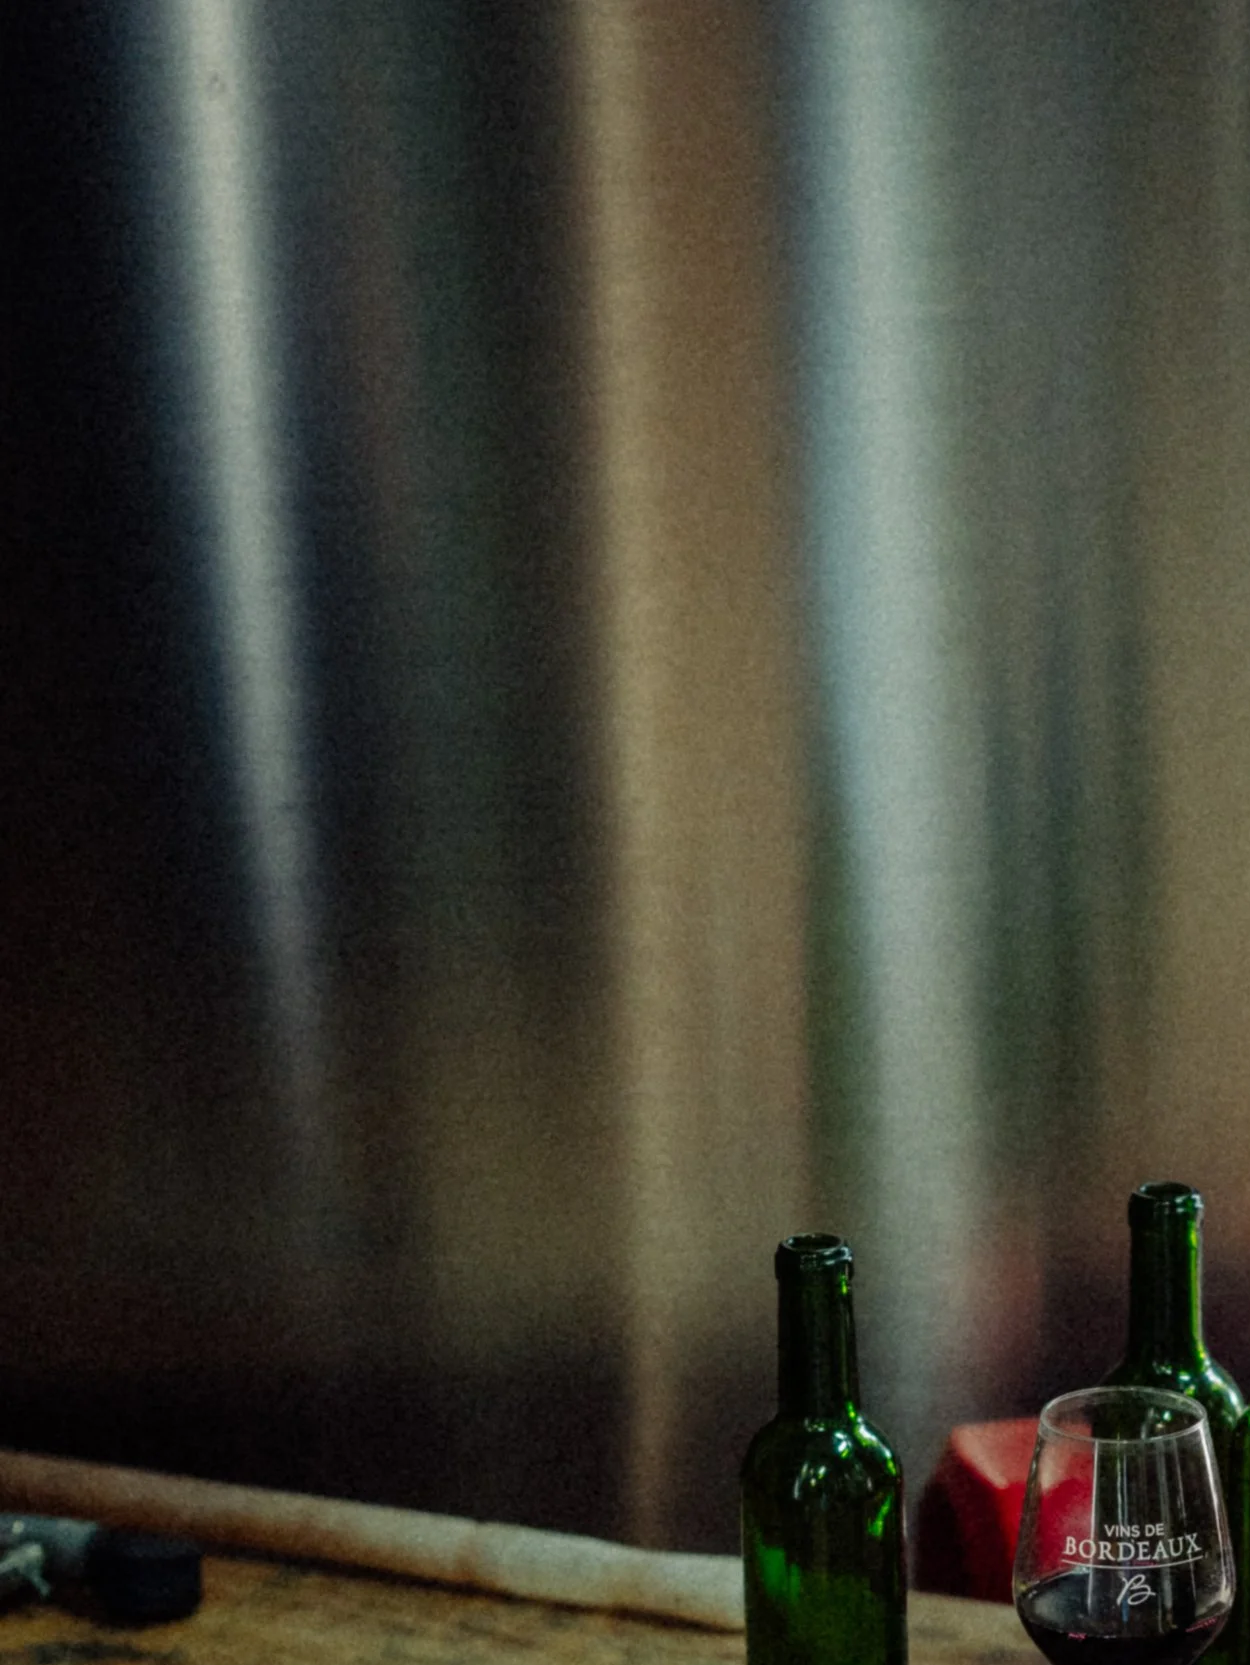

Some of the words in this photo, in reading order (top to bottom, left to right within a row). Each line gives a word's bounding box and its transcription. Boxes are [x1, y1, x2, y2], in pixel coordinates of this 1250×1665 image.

[1104, 1524, 1140, 1537] VINS
[1144, 1523, 1165, 1536] DE
[1063, 1533, 1202, 1561] BORDEAUX
